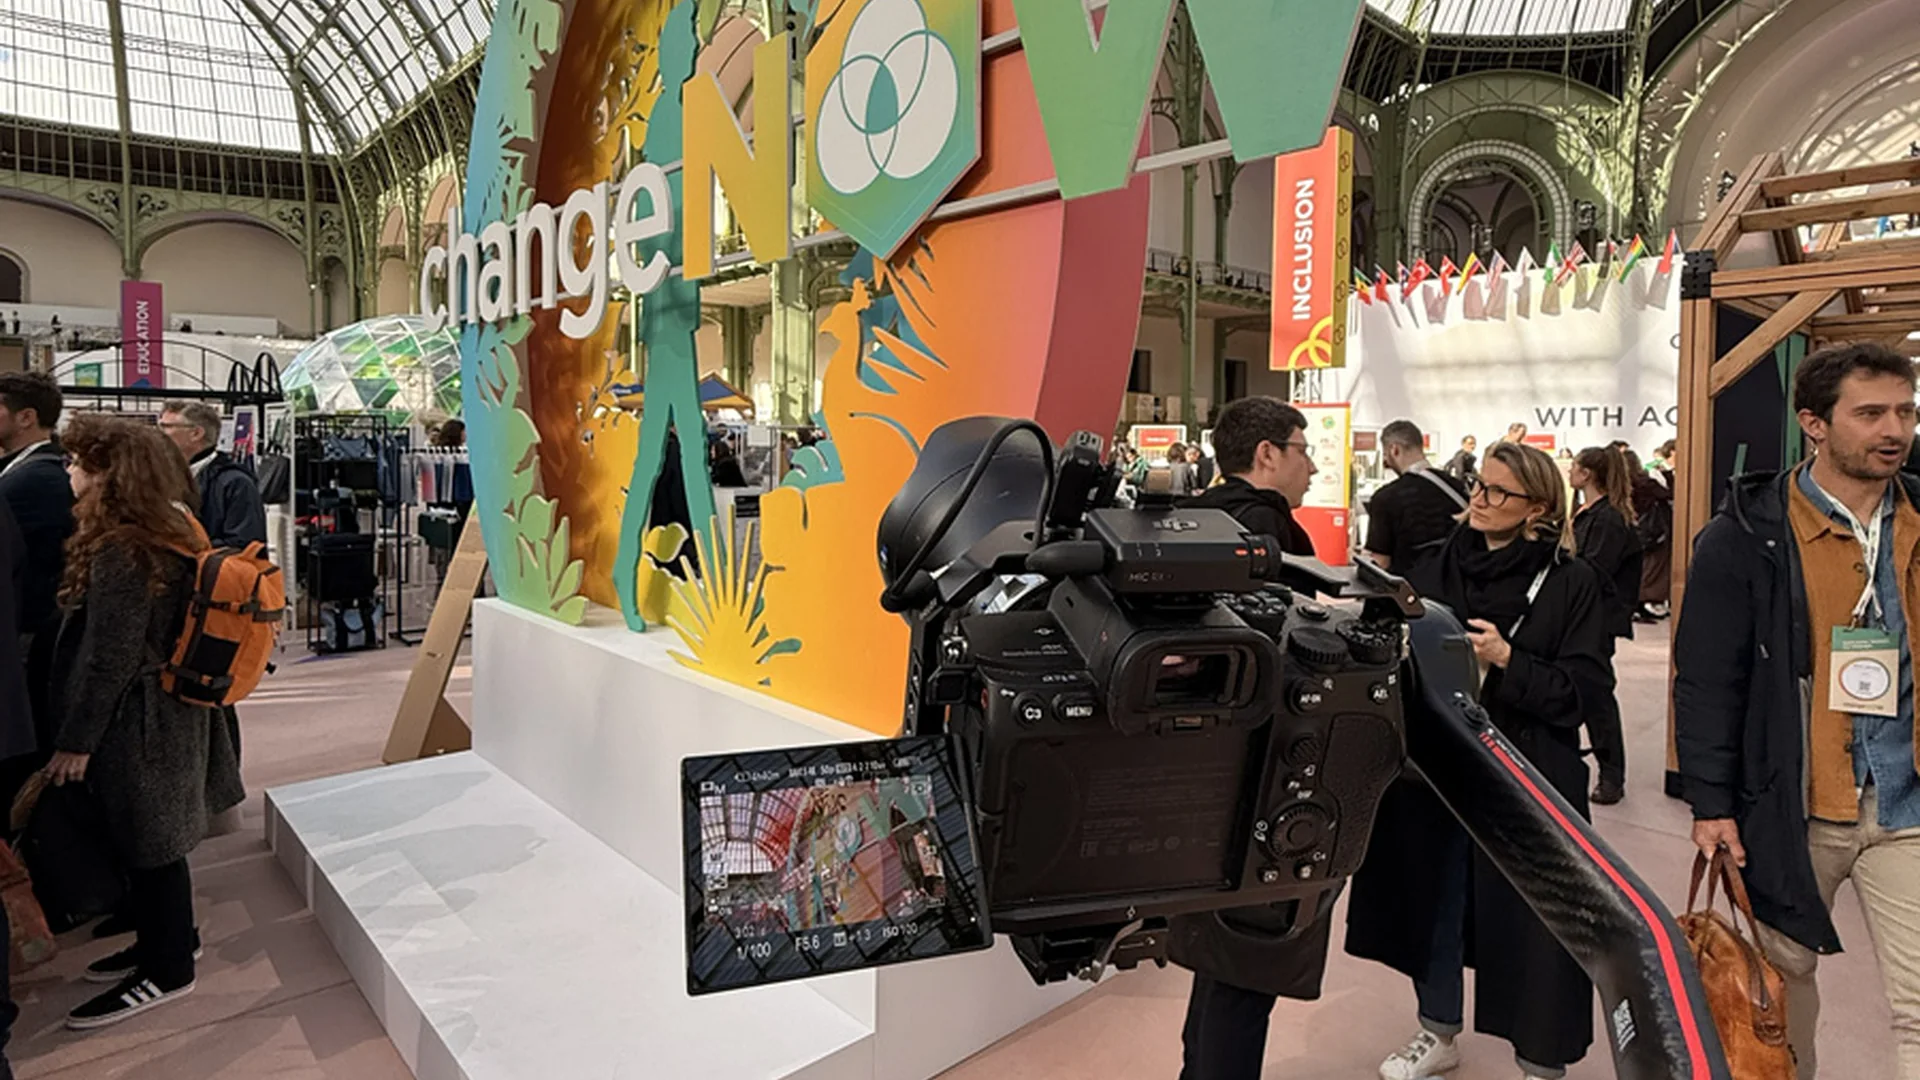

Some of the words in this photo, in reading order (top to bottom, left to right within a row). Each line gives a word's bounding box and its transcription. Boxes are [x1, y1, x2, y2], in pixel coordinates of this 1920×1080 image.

[1292, 177, 1315, 320] INCLUSION
[1535, 407, 1623, 427] WITH
[1025, 706, 1042, 720] C3
[1066, 706, 1093, 717] MENU
[737, 941, 772, 960] 1/100
[795, 935, 820, 952] F5.6
[882, 926, 899, 938] ISO
